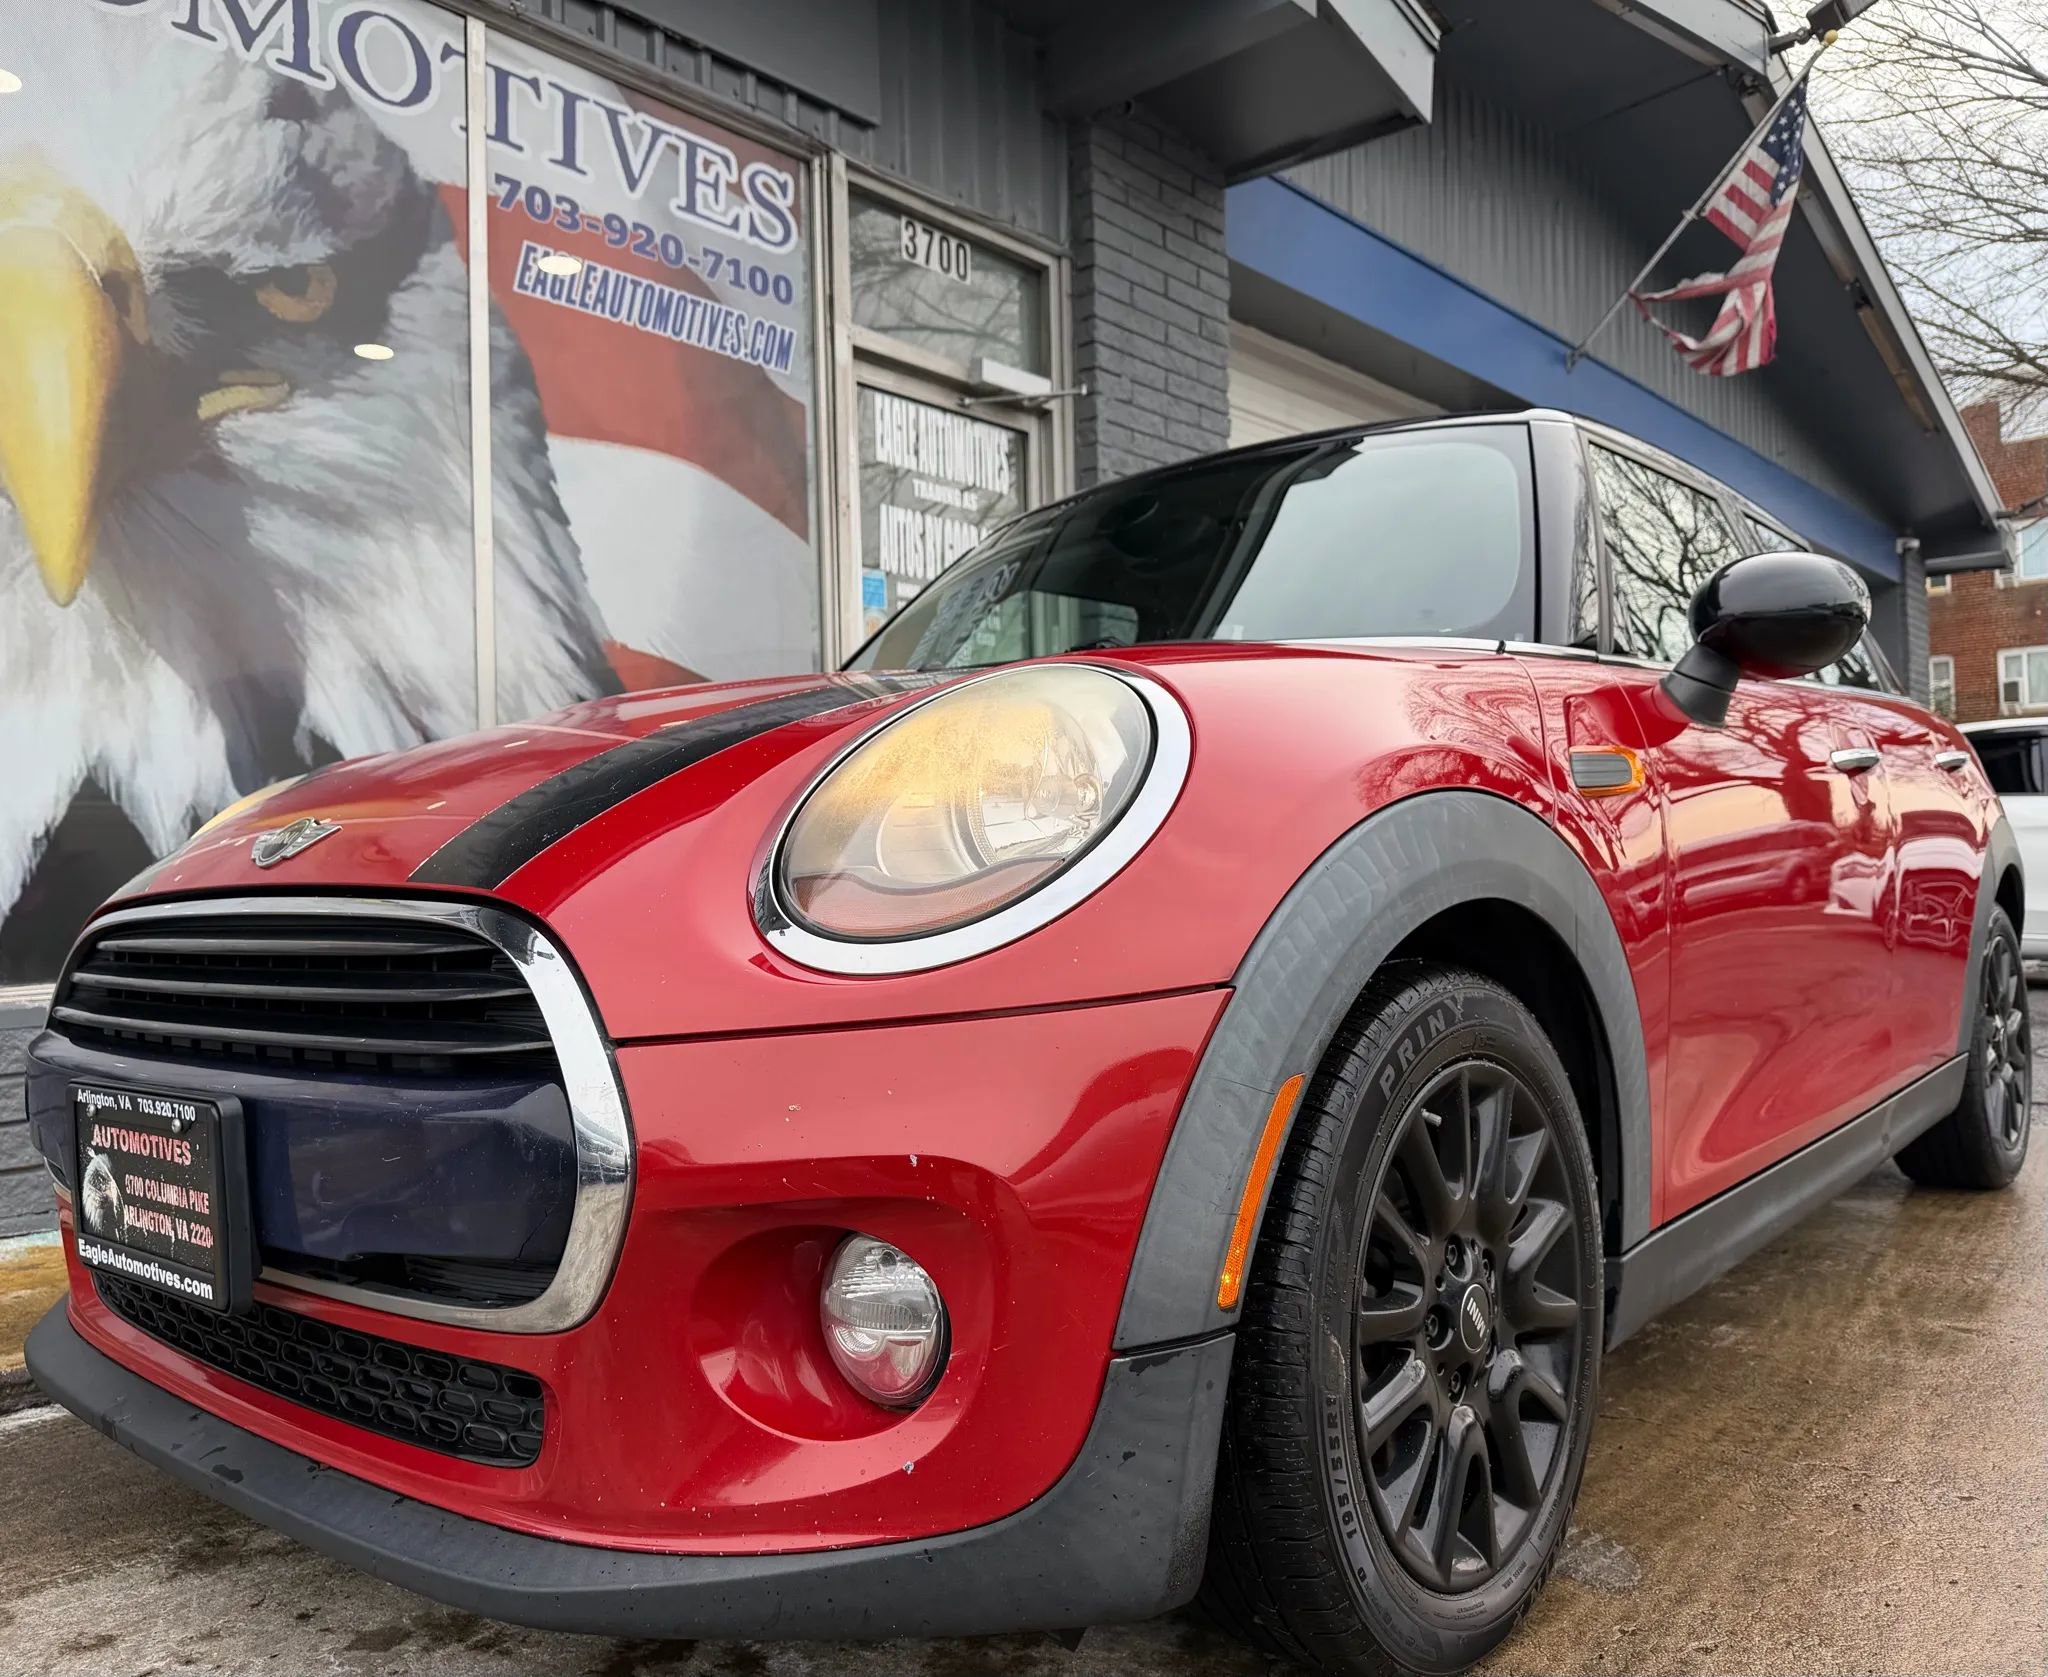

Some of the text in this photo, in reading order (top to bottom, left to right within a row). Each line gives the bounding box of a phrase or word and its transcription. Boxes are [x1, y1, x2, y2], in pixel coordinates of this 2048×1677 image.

[493, 171, 793, 305] 703-920-7100
[904, 219, 969, 283] 3700
[516, 242, 796, 372] EAGLEAUTOMOTIVES.COM
[874, 392, 1010, 496] EAGLE AUTOMOTIVES
[879, 503, 924, 580] AUTOS
[925, 513, 943, 581] BY
[77, 1088, 196, 1121] Arlington, VA 703.920.7100
[91, 1123, 192, 1166] AUTOMOTIVES
[145, 1178, 189, 1210] COLUMBIA
[189, 1189, 210, 1215] PIKE
[175, 1217, 189, 1242] VA
[190, 1222, 214, 1249] 2220
[78, 1238, 214, 1301] EagleAutomotives.com
[1466, 1296, 1487, 1339] MINI
